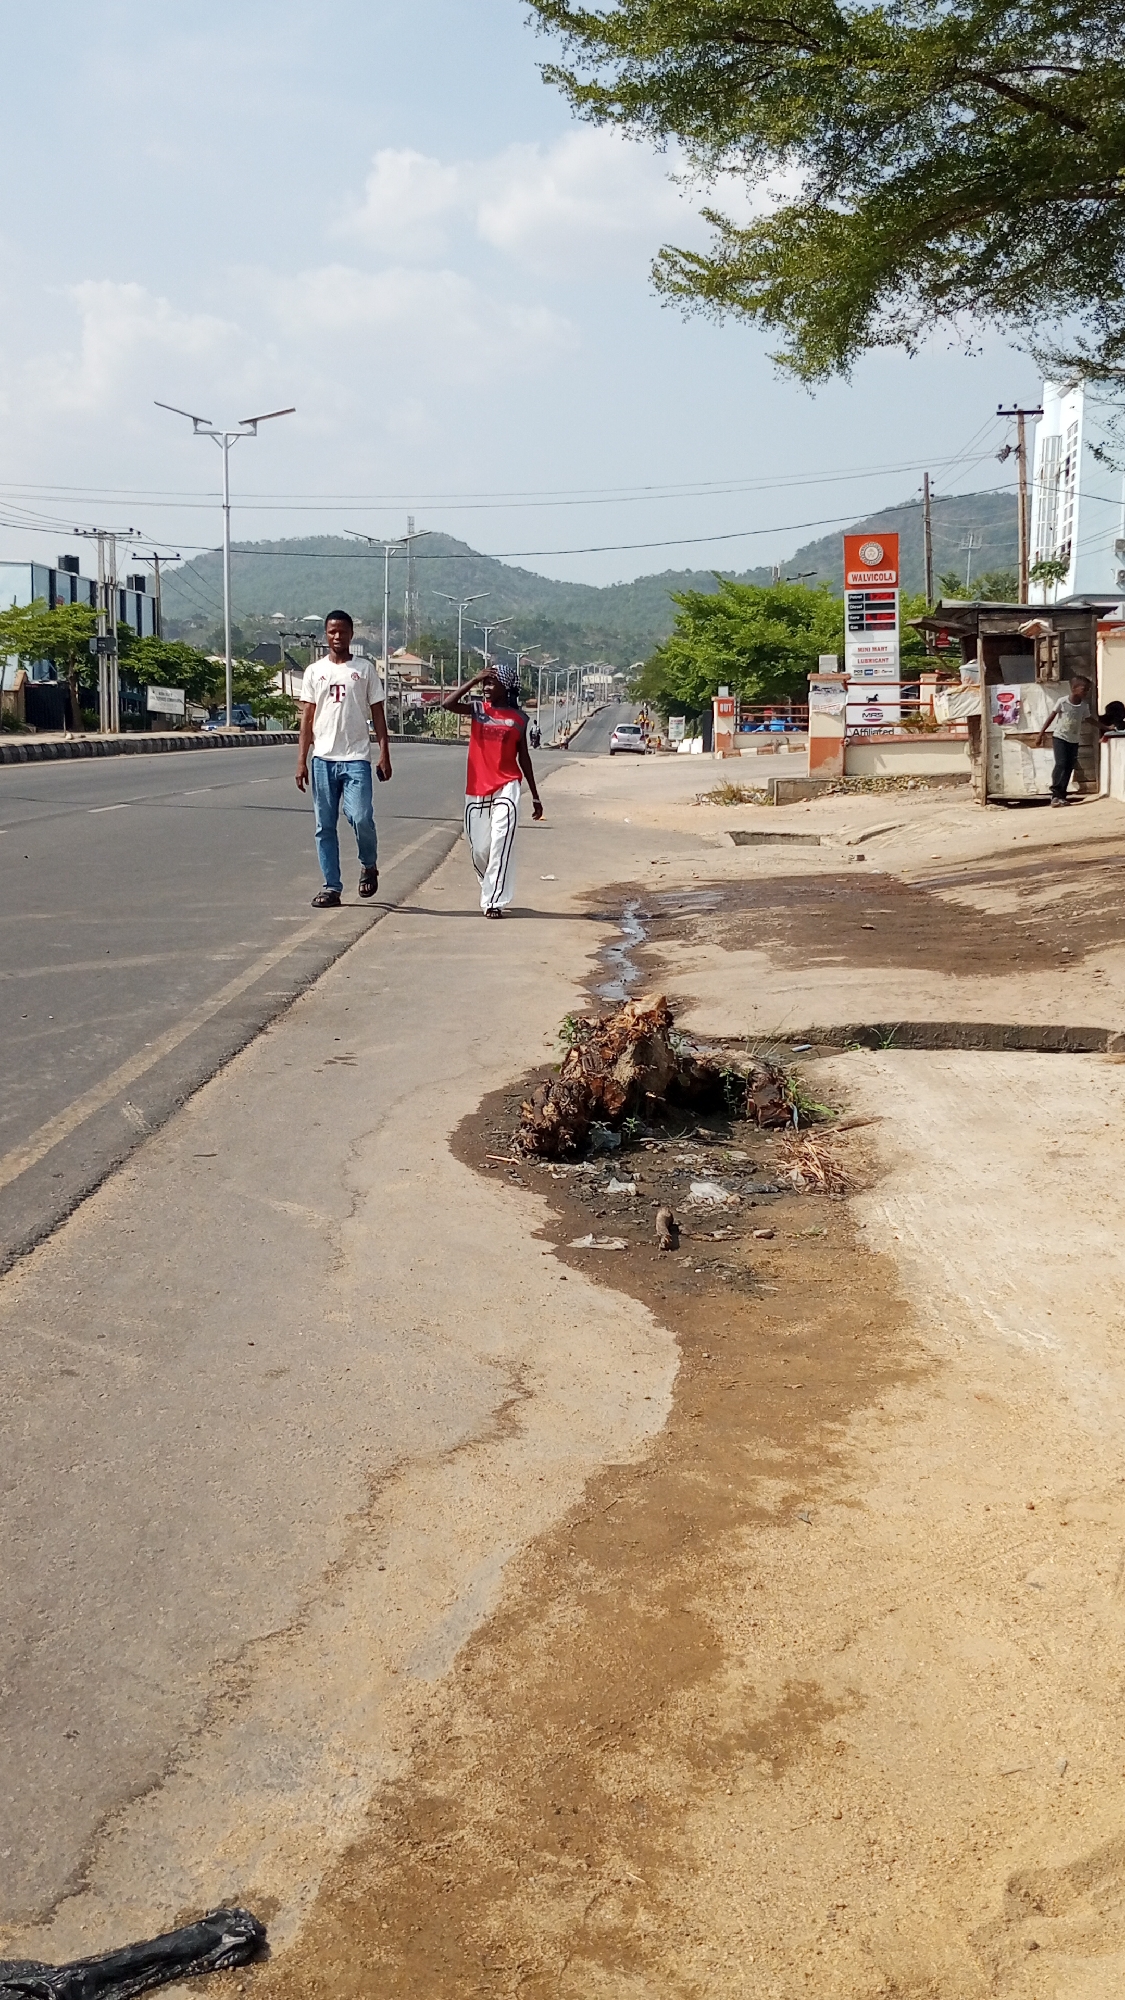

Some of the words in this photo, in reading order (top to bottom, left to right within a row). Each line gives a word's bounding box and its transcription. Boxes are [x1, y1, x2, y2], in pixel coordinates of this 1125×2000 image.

[851, 572, 893, 582] WALVICOLA
[329, 684, 346, 704] T
[719, 703, 732, 713] OUT
[852, 727, 895, 737] Affiliated
